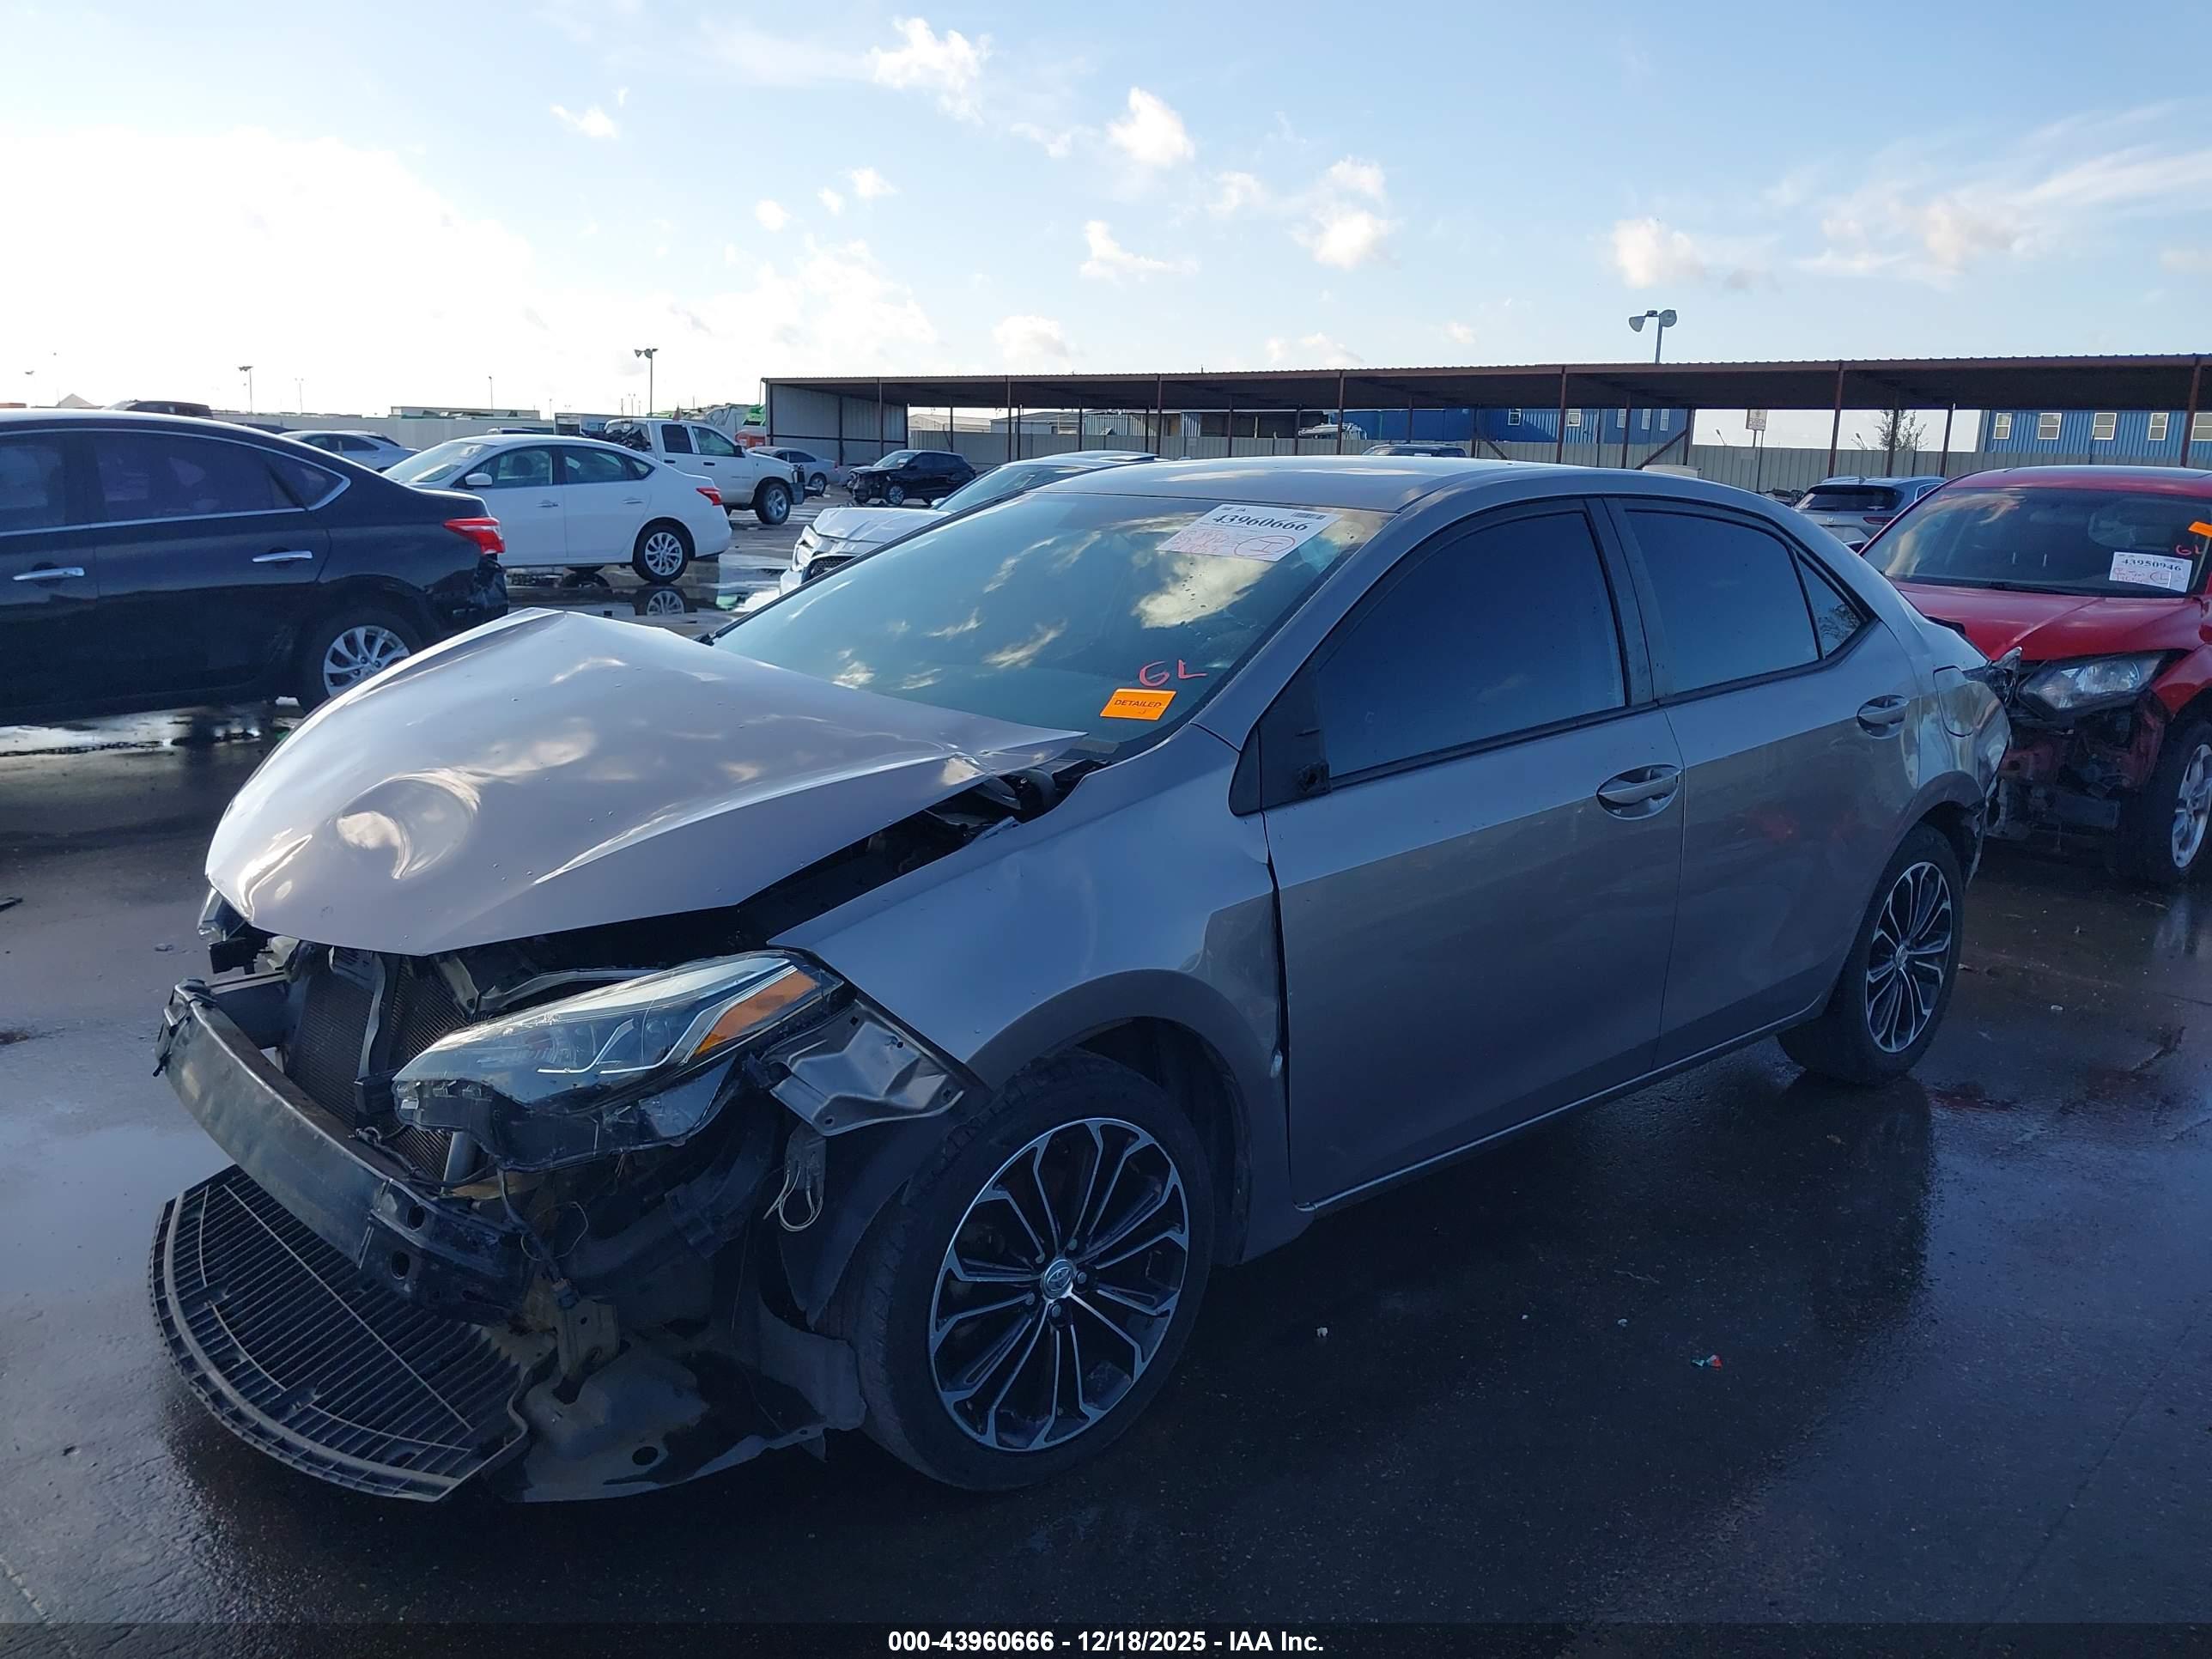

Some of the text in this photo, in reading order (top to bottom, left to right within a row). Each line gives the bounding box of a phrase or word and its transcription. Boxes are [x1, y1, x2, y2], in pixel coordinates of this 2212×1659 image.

[1212, 515, 1312, 531] 43960666
[2123, 559, 2182, 571] 43950946
[1114, 699, 1163, 708] DETAILED
